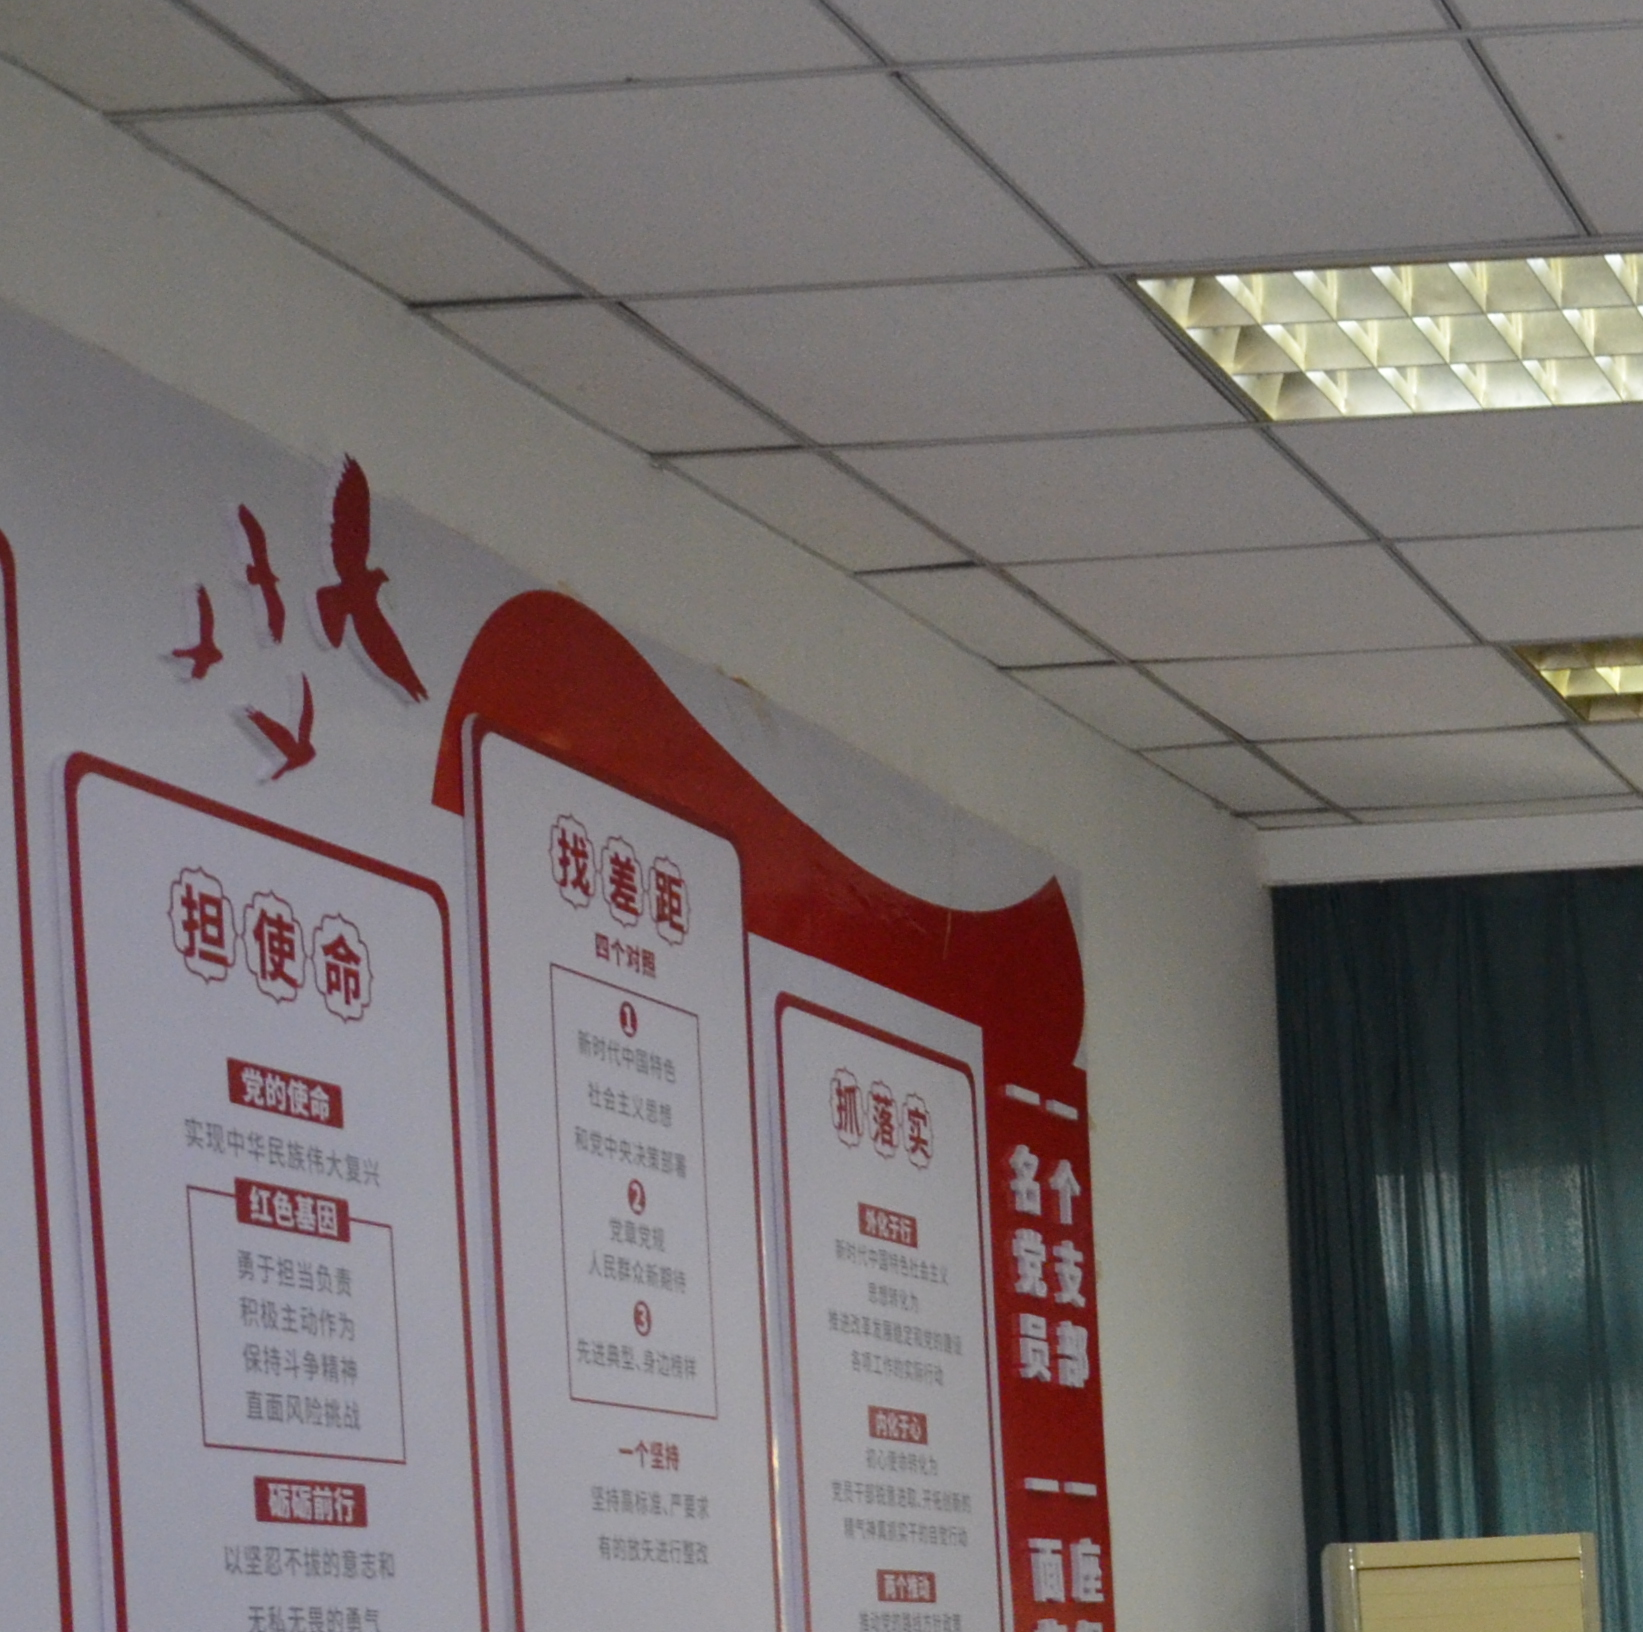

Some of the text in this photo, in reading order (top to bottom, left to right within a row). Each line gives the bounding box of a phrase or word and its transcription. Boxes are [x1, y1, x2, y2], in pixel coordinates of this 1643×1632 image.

[557, 826, 686, 934] 找差距
[180, 882, 363, 1006] 担使命
[595, 932, 657, 979] 四个对照
[241, 1066, 332, 1121] 党的使命
[835, 1085, 932, 1161] 抓落实
[184, 1117, 381, 1189] 实现中华民族伟大复兴
[249, 1190, 340, 1238] 红色基因
[1004, 1083, 1052, 1382] 一名党员
[1046, 1099, 1090, 1388] 一个支部
[236, 1250, 352, 1297] 勇于担当负责
[239, 1297, 356, 1341] 积极主动作为
[242, 1344, 358, 1386] 保持斗争精神
[245, 1391, 361, 1430] 直面风险挑战
[618, 1440, 681, 1471] 一个坚持
